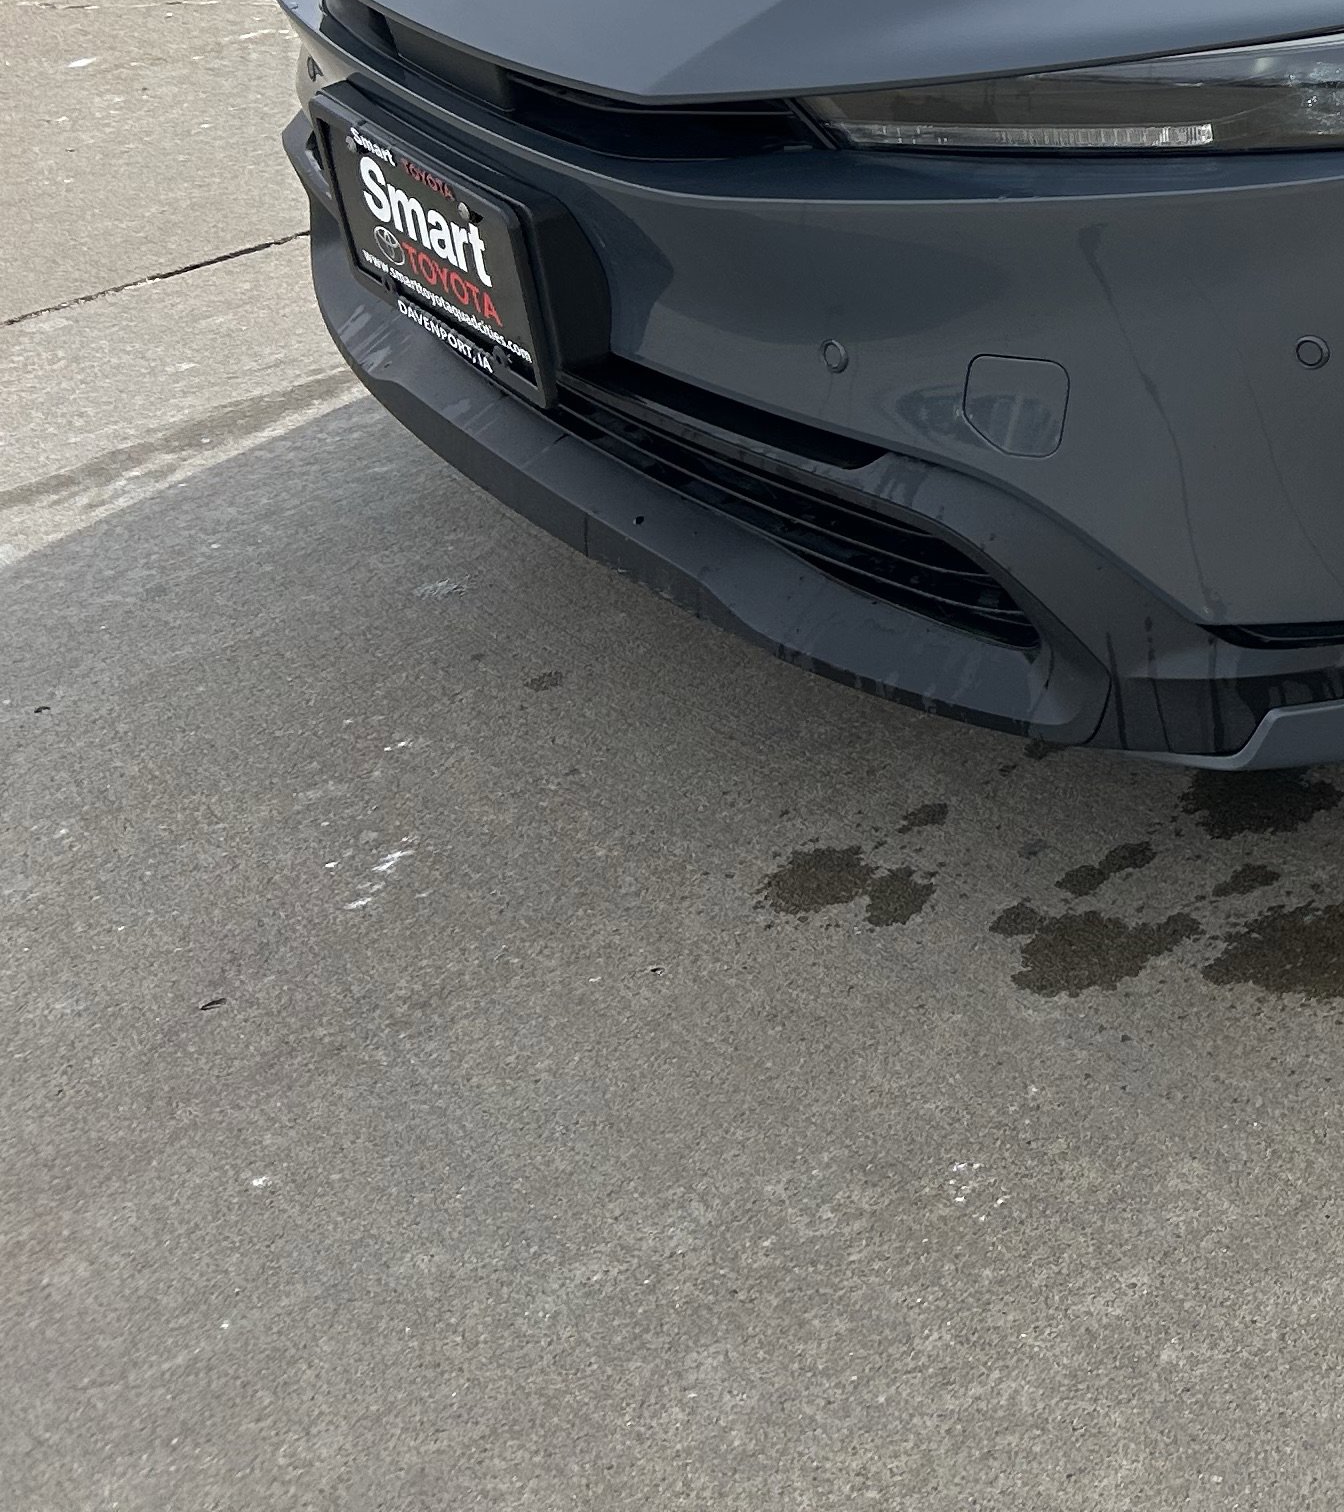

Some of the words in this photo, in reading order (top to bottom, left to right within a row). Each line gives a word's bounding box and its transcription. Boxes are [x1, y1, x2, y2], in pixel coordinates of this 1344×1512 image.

[350, 127, 397, 167] Smart
[400, 157, 455, 201] TOYOTA
[360, 156, 492, 288] Smart
[362, 249, 533, 364] www.smarttoyotaquadcities.com
[401, 242, 503, 327] TOYOTA
